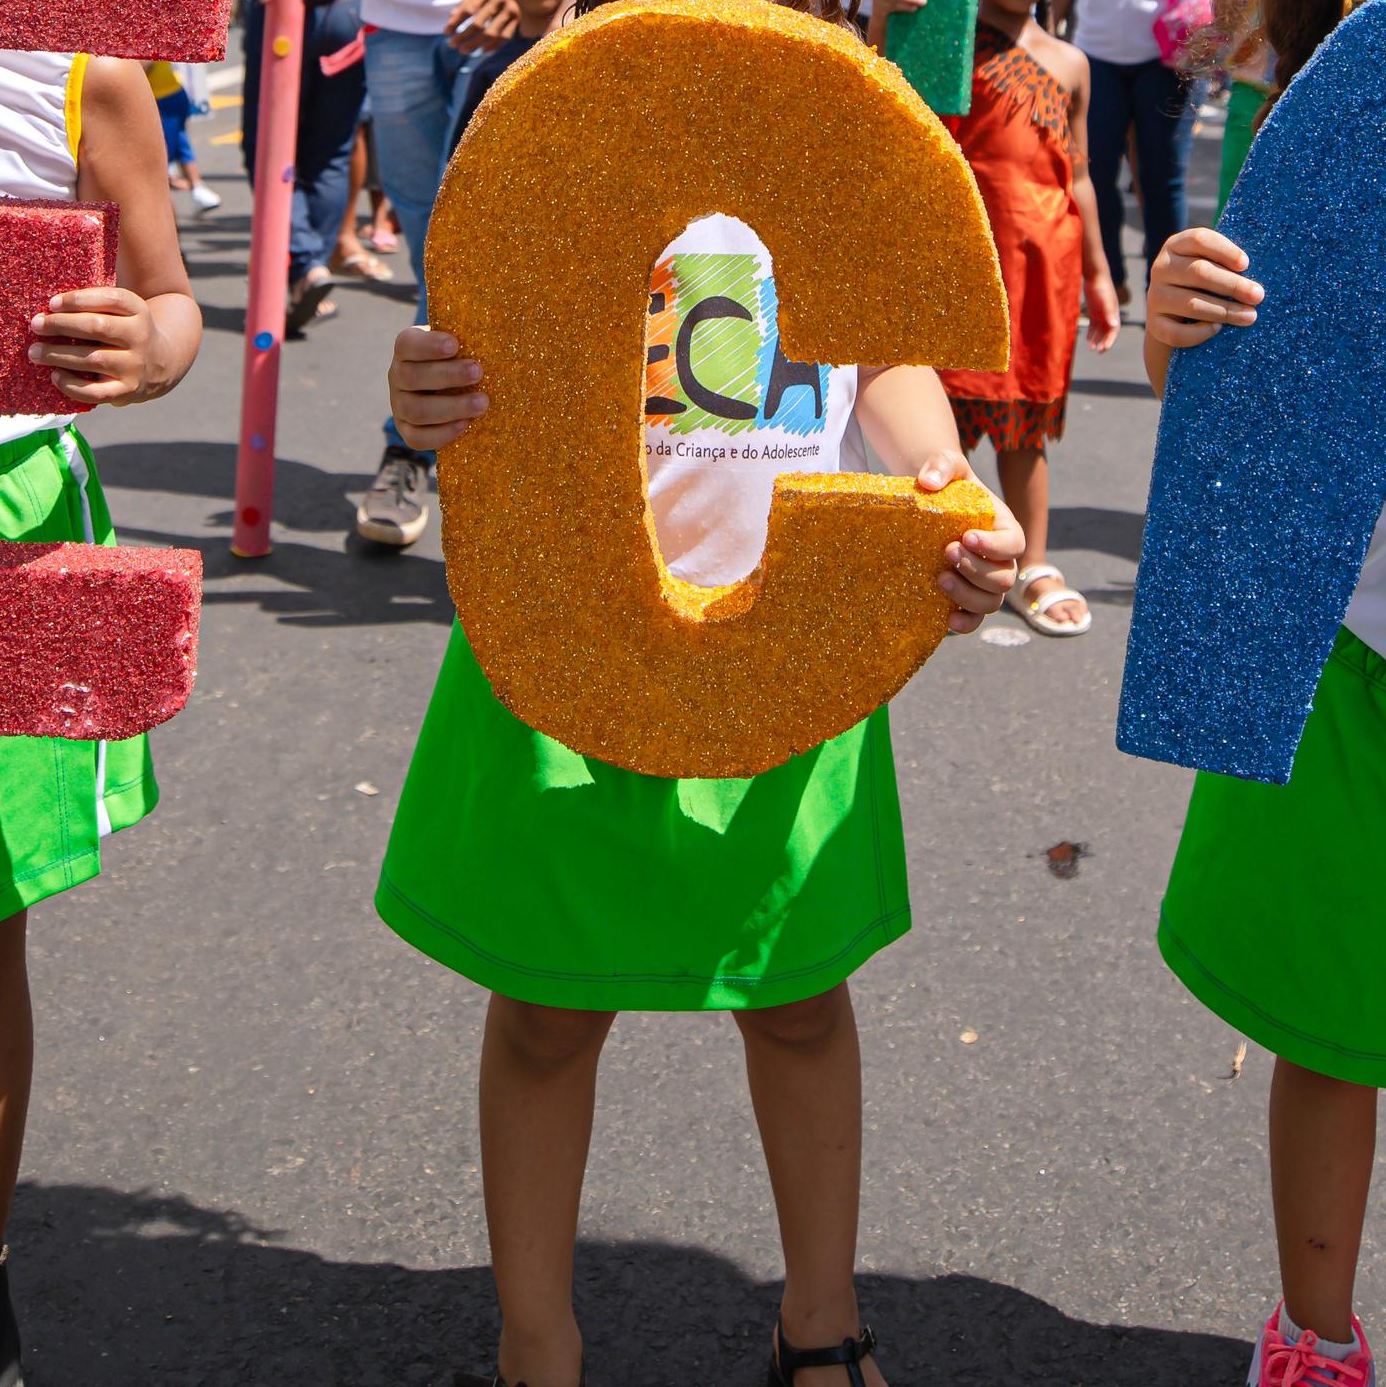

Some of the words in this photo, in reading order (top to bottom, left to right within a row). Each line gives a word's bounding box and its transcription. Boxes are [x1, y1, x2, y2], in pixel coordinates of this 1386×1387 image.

[656, 441, 671, 456] da
[676, 442, 725, 462] Criança
[730, 448, 738, 459] e
[742, 444, 758, 459] do
[761, 444, 820, 460] Adolescente
